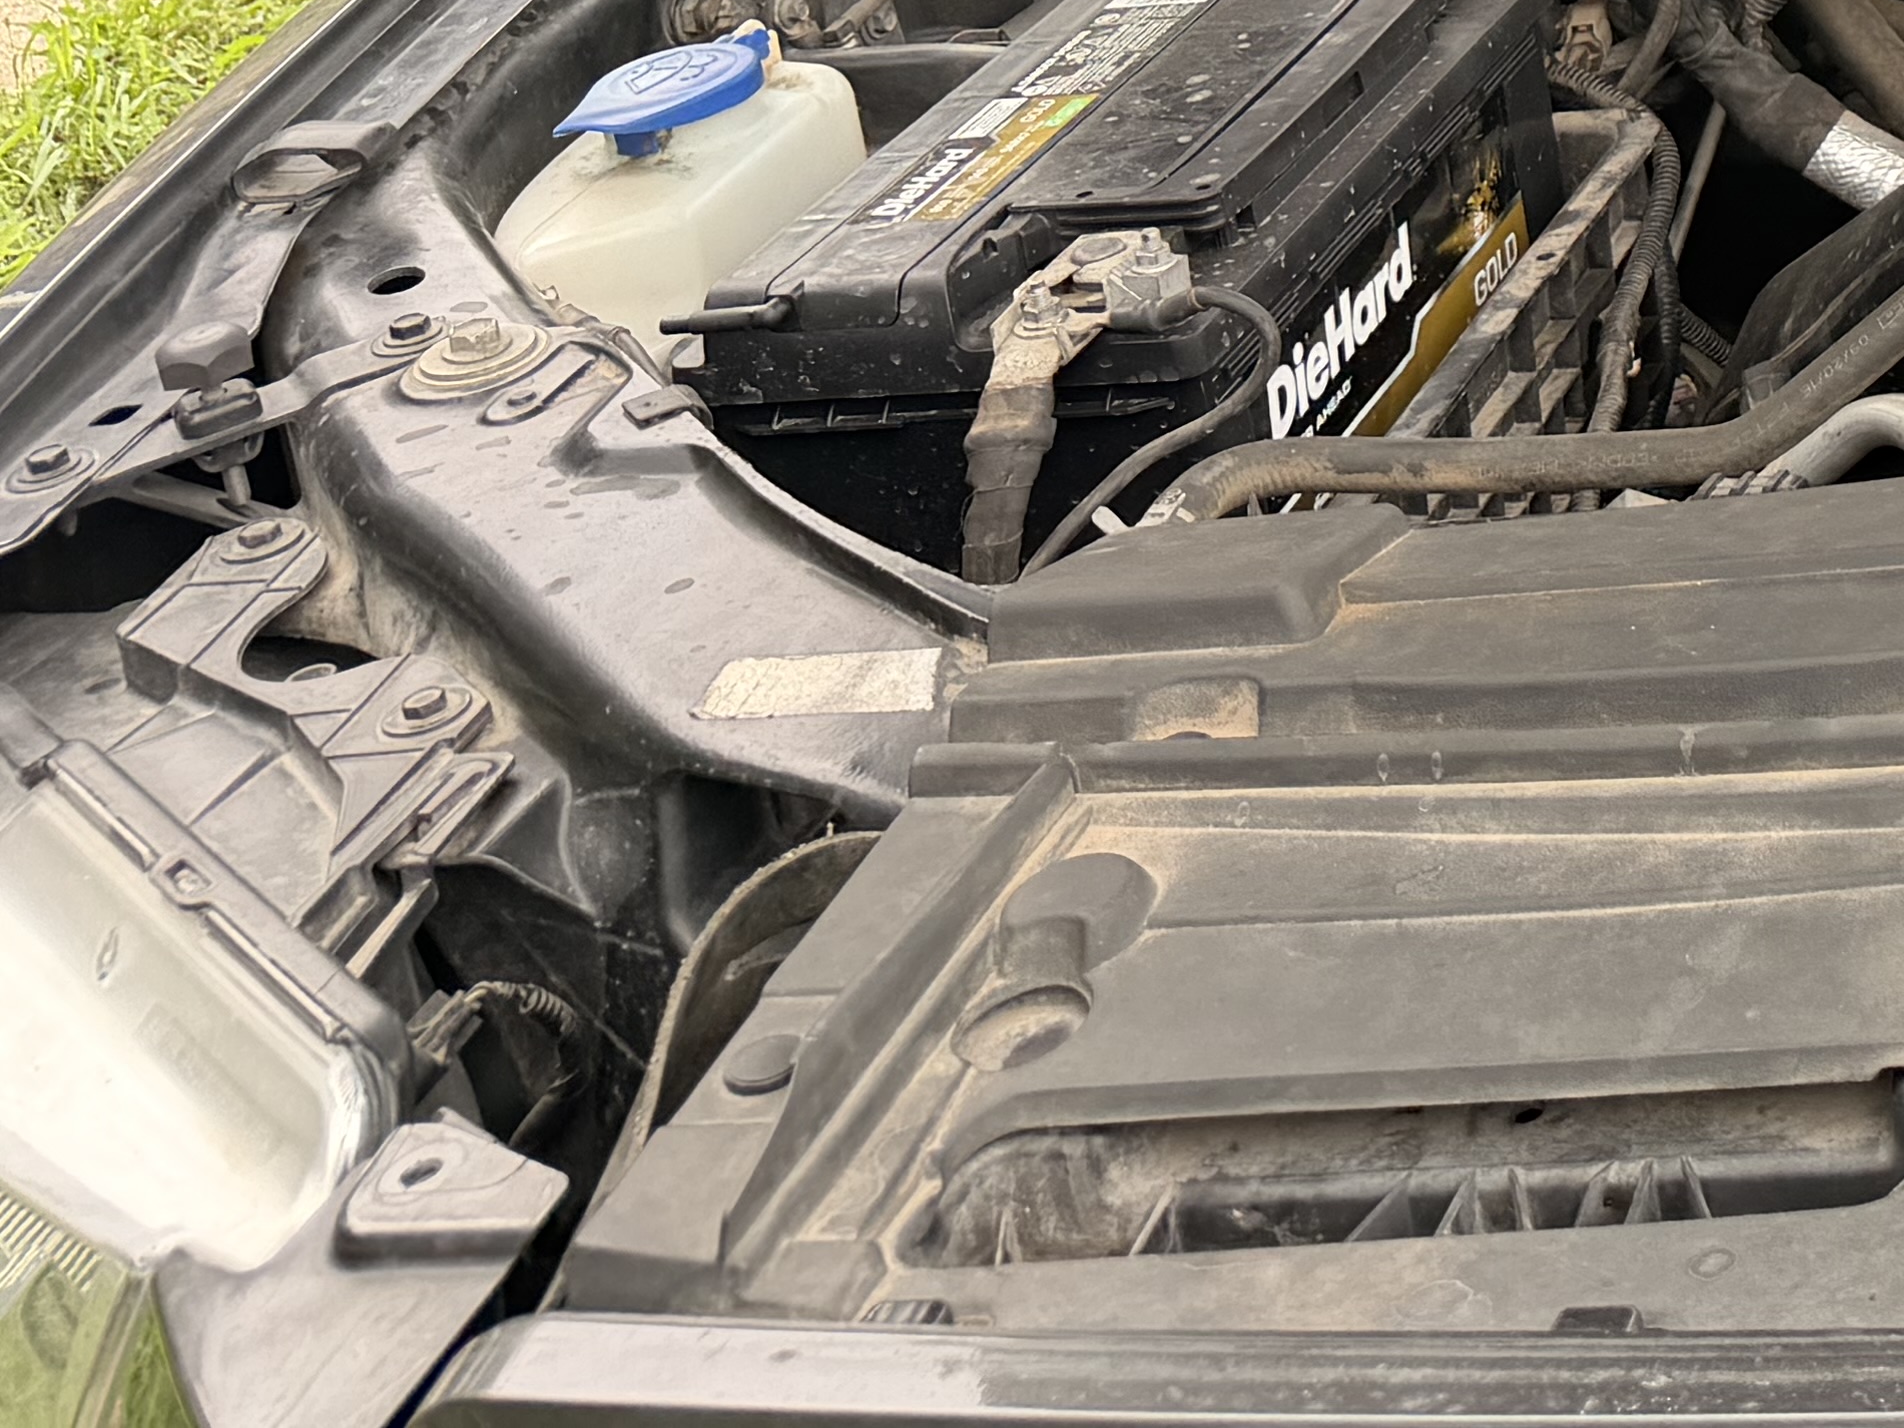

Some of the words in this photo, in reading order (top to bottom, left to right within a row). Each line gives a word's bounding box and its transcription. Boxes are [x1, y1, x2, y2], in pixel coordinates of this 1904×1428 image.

[1020, 98, 1056, 123] GOLD
[871, 148, 974, 217] DieHard
[1473, 231, 1519, 307] GOLD
[1266, 220, 1414, 440] DieHard
